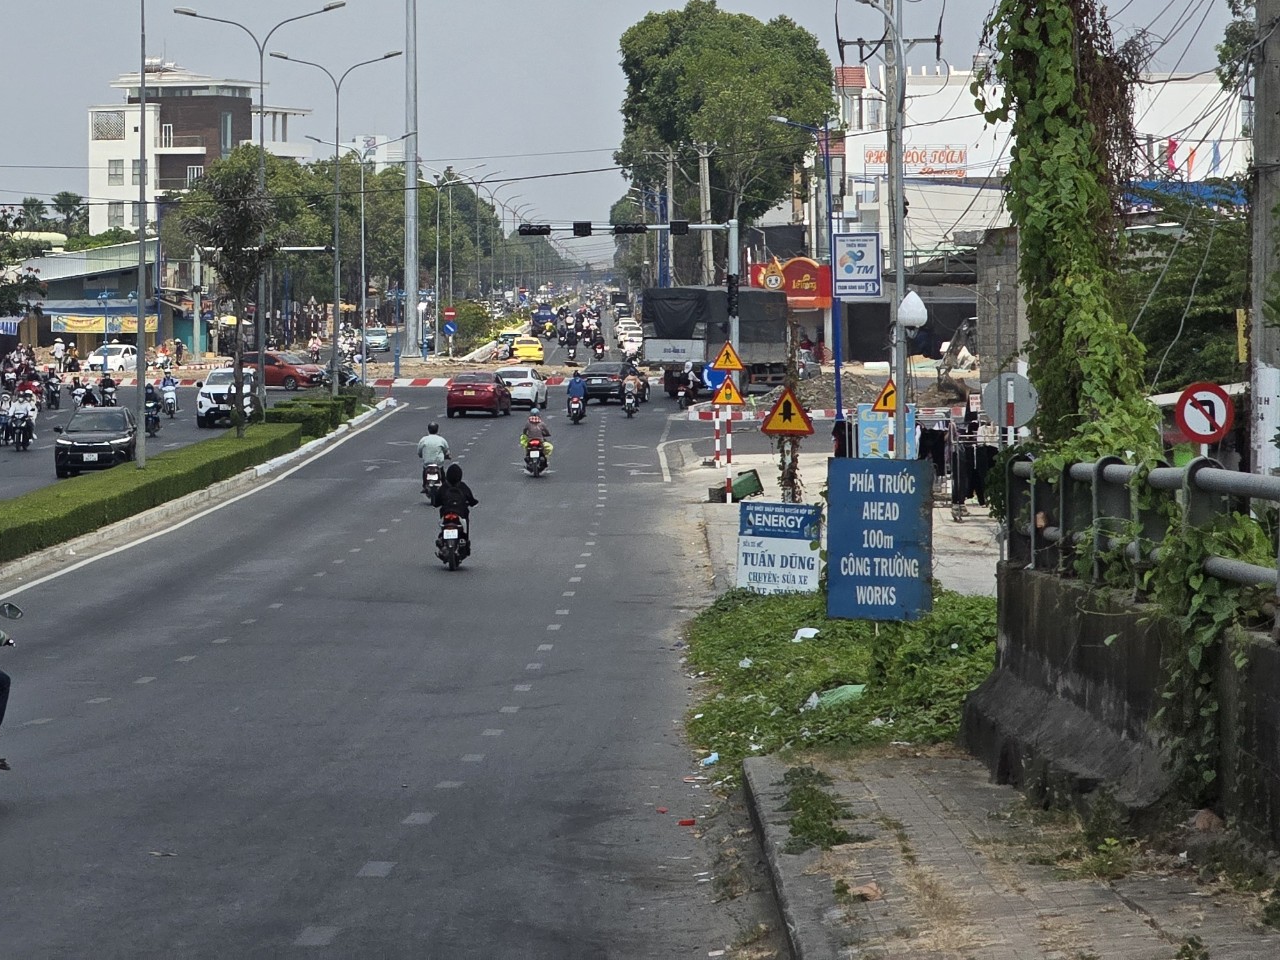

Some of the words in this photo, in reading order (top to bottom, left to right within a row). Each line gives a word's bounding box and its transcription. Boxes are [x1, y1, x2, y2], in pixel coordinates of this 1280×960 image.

[856, 265, 875, 274] TM
[849, 469, 875, 492] PHÍA
[878, 468, 916, 494] TRƯỚC
[755, 513, 804, 528] ENERGY
[862, 501, 900, 521] AHEAD
[862, 529, 894, 549] 100m
[742, 549, 776, 567] TUẤN
[780, 553, 815, 570] DŨNG
[840, 552, 870, 576] CÔNG
[873, 552, 919, 578] TRƯỜNG
[798, 576, 808, 585] XE
[856, 586, 896, 606] WORKS
